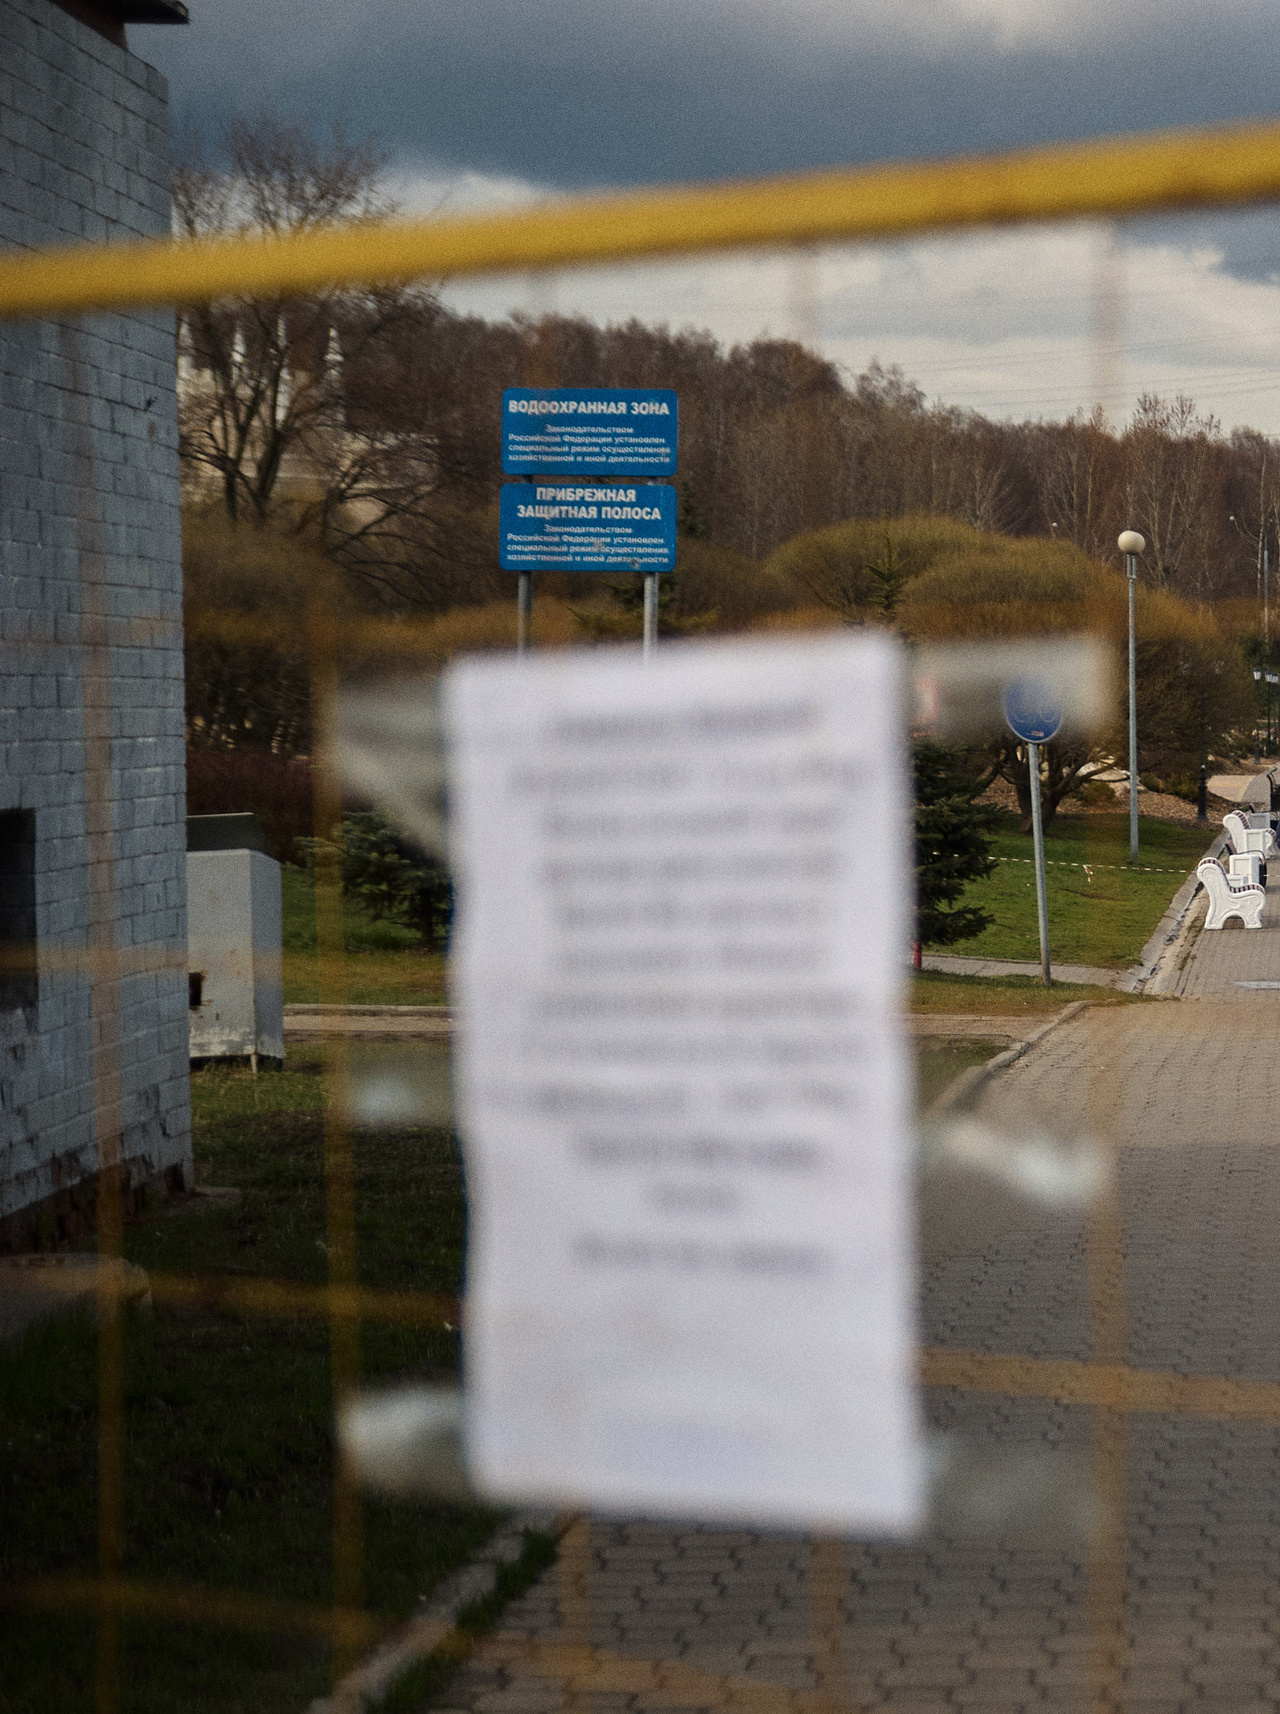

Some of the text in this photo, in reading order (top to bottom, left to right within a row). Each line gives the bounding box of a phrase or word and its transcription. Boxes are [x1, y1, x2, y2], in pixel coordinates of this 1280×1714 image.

[508, 400, 670, 415] ВОДООХРАННАЯ ЗОНА
[545, 424, 634, 434] Законодательством
[508, 434, 665, 444] Российской Федерации установлен
[508, 444, 670, 454] специальный режим осуществления
[536, 488, 636, 502] ПРИБРЕЖНАЯ
[517, 505, 662, 520] ЗАЩИТНАЯ ПОЛОСА
[544, 524, 632, 534] Законодательством
[507, 534, 664, 544] Российской Федерации установлен
[507, 544, 568, 552] специальный
[506, 554, 573, 562] хозяйственной
